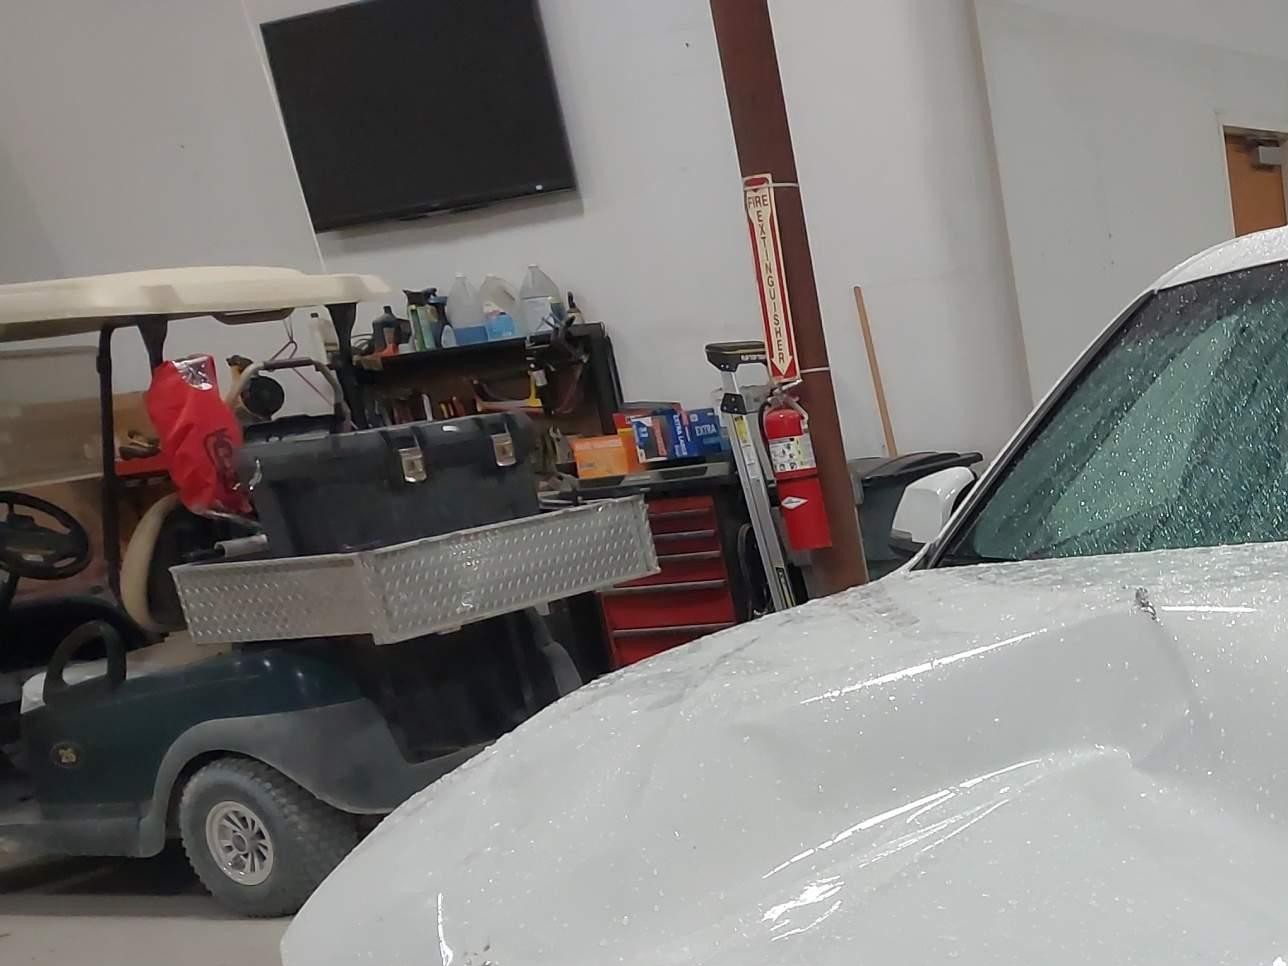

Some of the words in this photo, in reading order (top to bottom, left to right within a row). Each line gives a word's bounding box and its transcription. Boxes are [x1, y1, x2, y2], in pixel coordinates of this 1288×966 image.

[748, 194, 769, 209] FIRE
[756, 210, 785, 364] EXTINGUISHER
[695, 423, 717, 437] EXTRA
